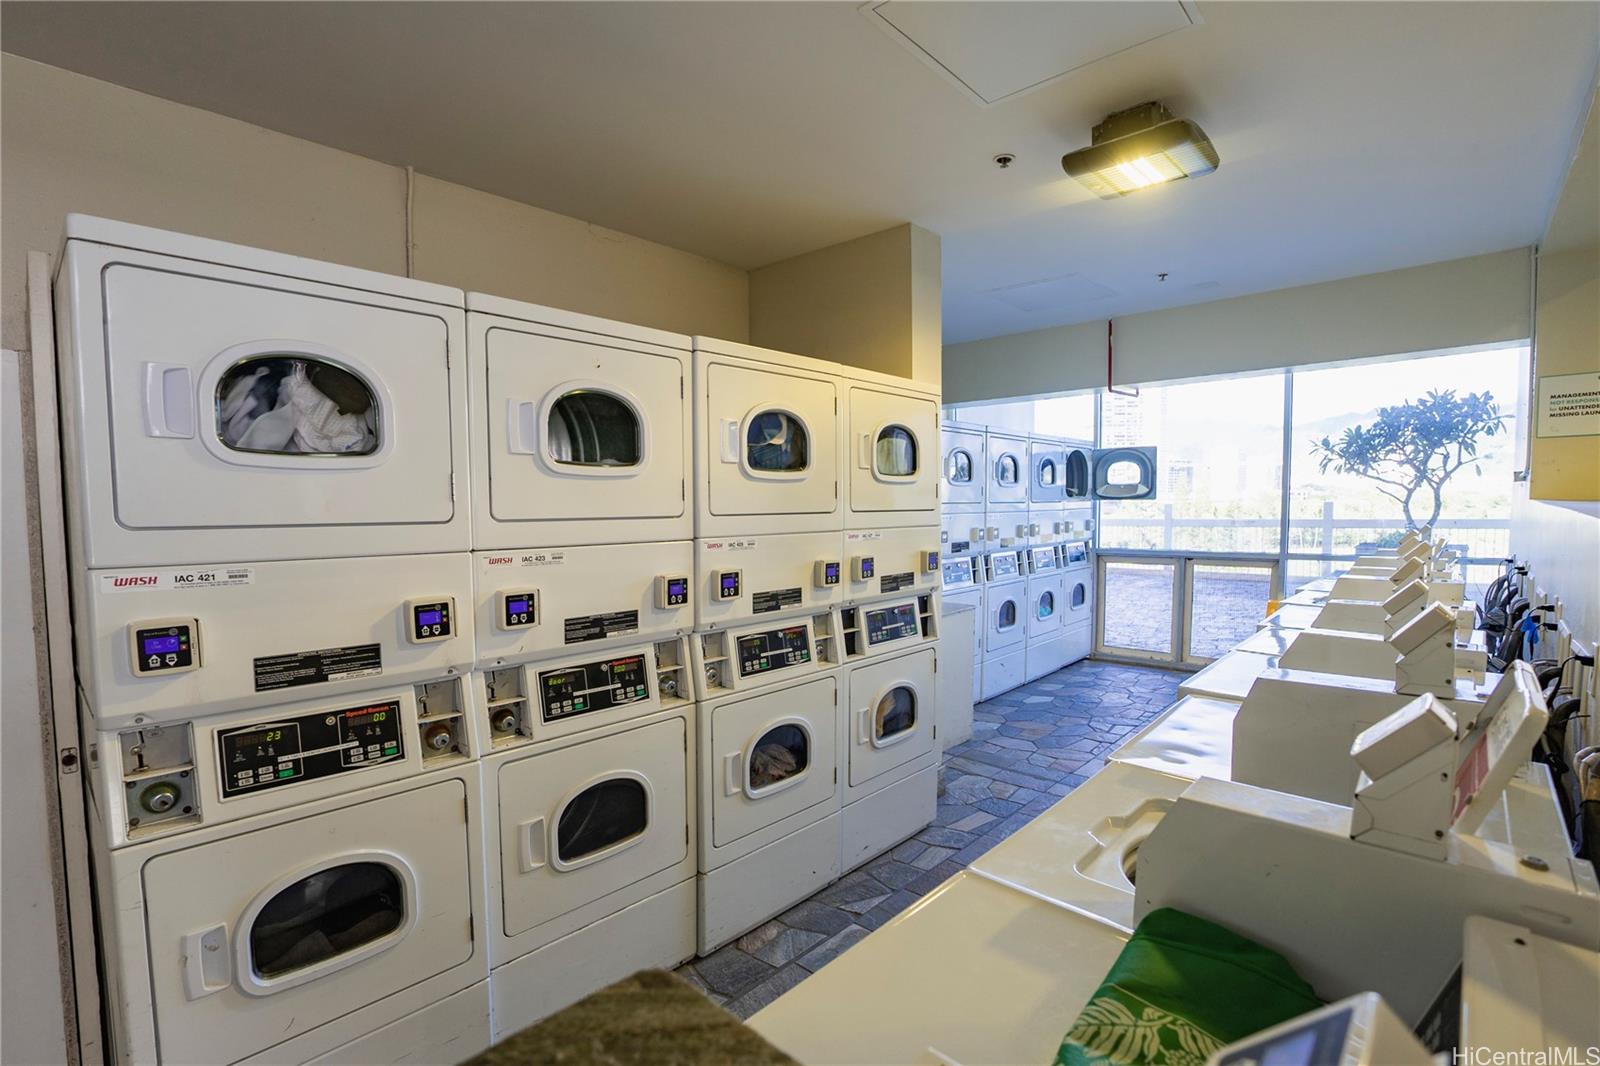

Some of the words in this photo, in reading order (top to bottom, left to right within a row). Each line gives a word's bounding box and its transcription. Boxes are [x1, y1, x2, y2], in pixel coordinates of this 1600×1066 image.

[1550, 391, 1600, 399] MANAGEMENT
[489, 557, 513, 565] WASH
[114, 576, 158, 587] WASH
[174, 574, 194, 583] IAC
[197, 573, 216, 582] 421
